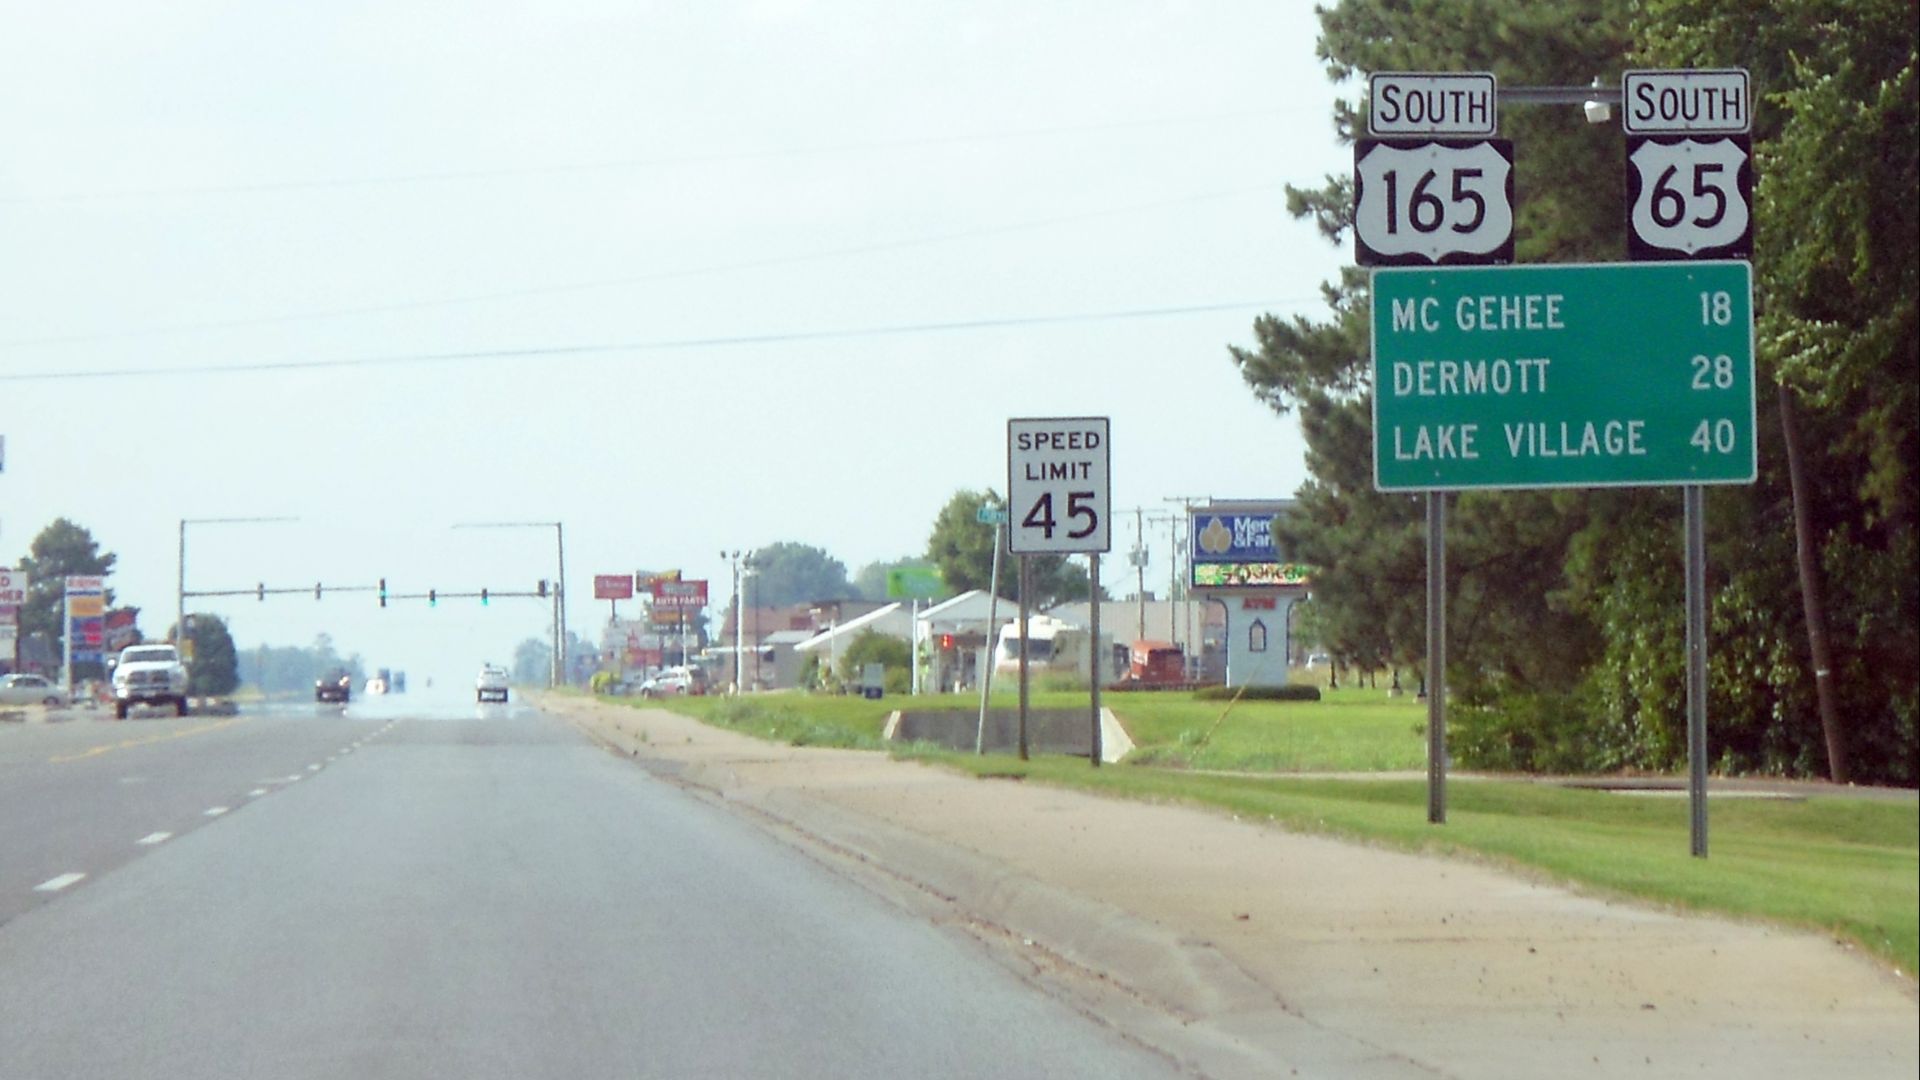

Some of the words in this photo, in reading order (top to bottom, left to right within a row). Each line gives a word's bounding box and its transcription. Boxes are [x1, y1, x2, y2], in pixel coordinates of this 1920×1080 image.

[1380, 83, 1488, 126] SOUTH
[1634, 82, 1742, 124] SOUTH
[1382, 168, 1487, 236] 165
[1650, 162, 1728, 229] 65
[1391, 298, 1440, 333] MC
[1456, 294, 1566, 331] GEHEE
[1699, 291, 1733, 326] 18
[1393, 358, 1551, 396] DERMOTT
[1690, 355, 1734, 390] 28
[1017, 431, 1100, 451] SPEED
[1394, 424, 1479, 461] LAKE
[1504, 420, 1647, 457] VILLAGE
[1689, 418, 1735, 454] 40
[1025, 462, 1092, 481] LIMIT
[1022, 491, 1098, 539] 45
